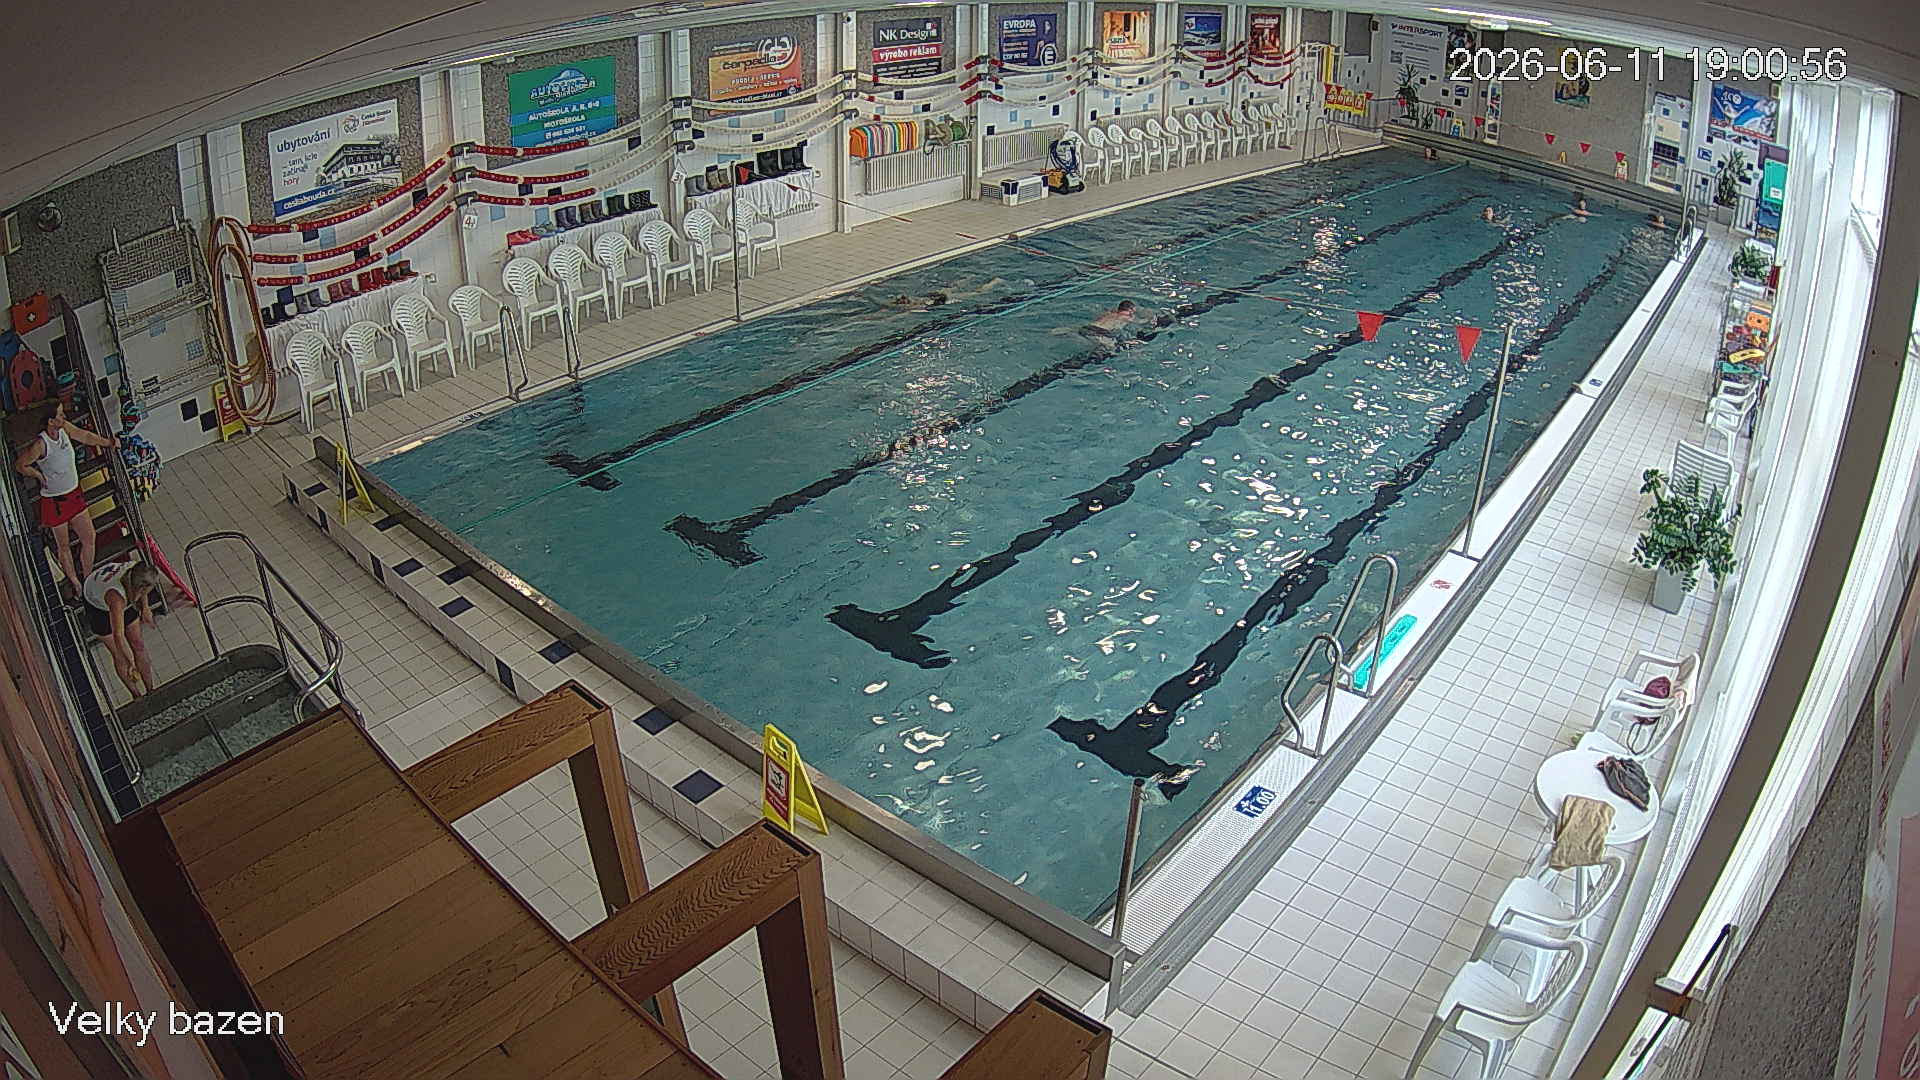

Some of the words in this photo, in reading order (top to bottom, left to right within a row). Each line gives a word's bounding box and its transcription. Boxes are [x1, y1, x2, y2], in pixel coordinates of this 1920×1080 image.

[1003, 19, 1036, 29] EVROPA
[880, 29, 897, 41] NK
[900, 28, 932, 40] Design
[528, 105, 570, 121] AUTOŠKOLA
[543, 114, 586, 128] MOTOŠKOLA
[276, 127, 332, 154] ubytování
